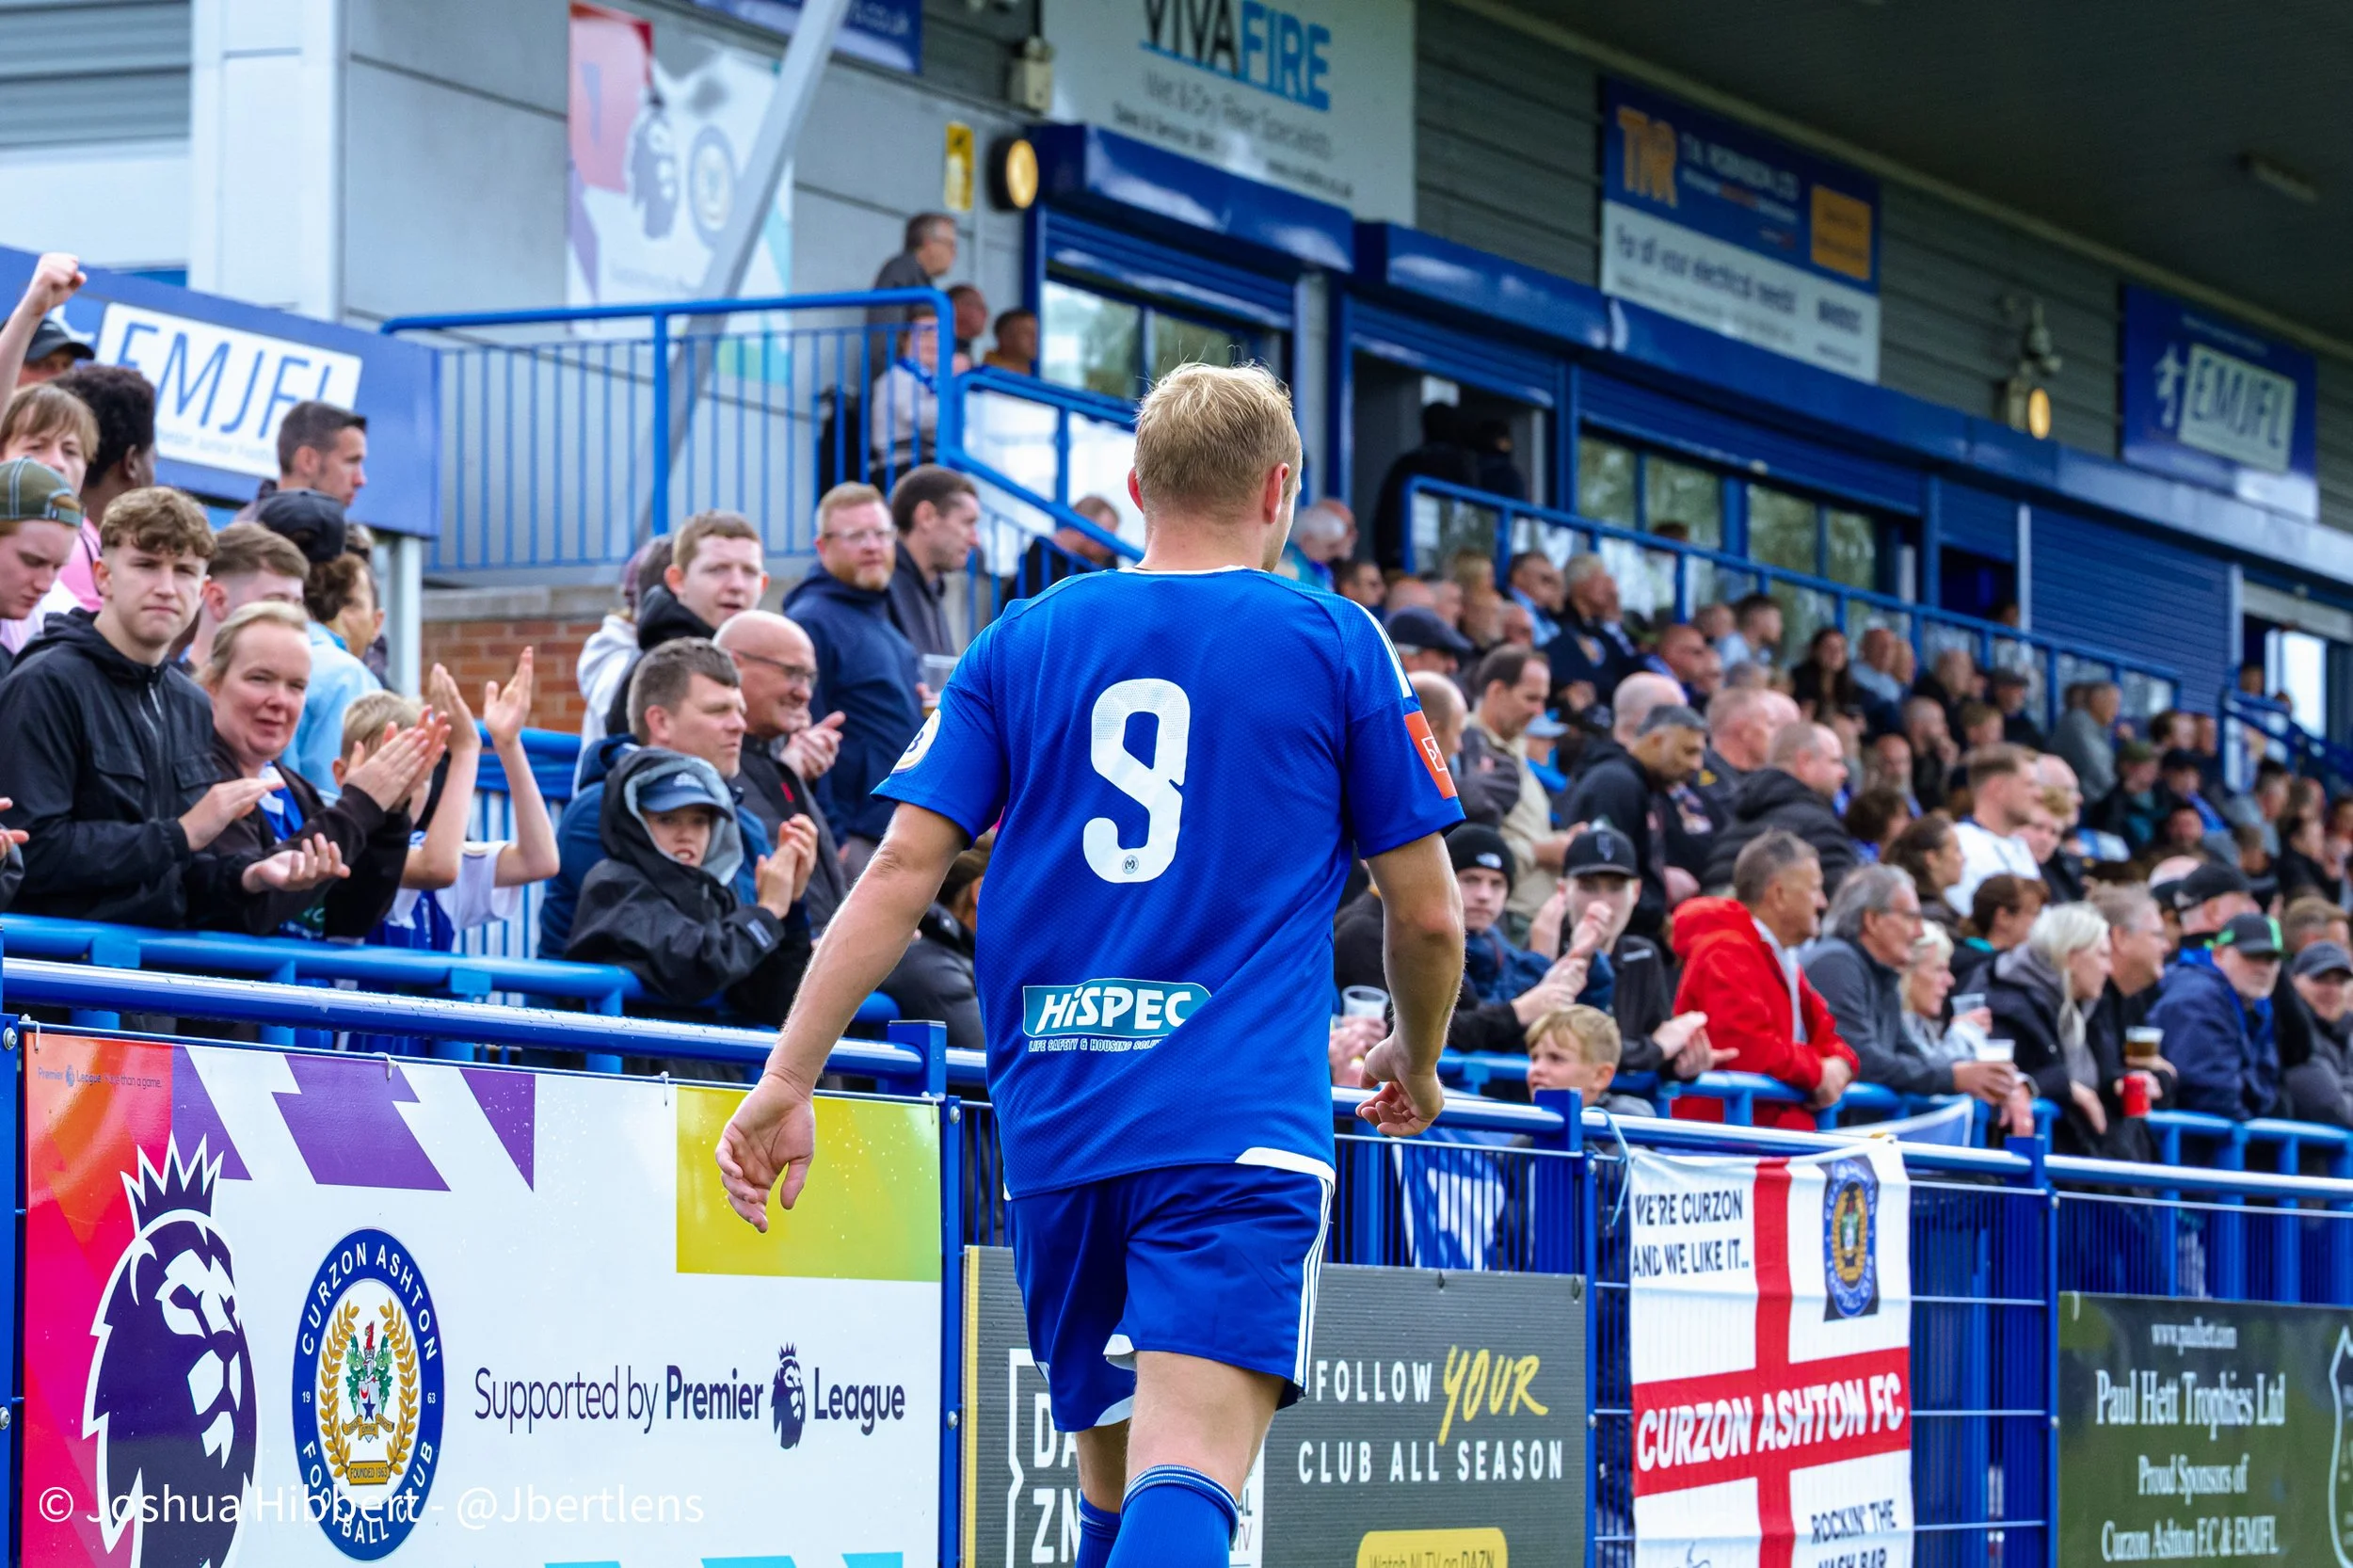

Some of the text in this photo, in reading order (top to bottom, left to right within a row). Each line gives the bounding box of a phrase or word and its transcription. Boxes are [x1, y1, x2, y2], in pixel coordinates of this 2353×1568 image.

[1082, 678, 1191, 884] 9
[1028, 1039, 1047, 1053] LIFE
[1048, 1037, 1079, 1052] SAFETY
[1080, 1037, 1088, 1051] &
[1090, 1038, 1131, 1052] HOUSING
[38, 1066, 64, 1080] Premier
[76, 1069, 102, 1085] League
[1682, 1189, 1743, 1224] CURZON
[1633, 1243, 1662, 1278] AND
[1664, 1242, 1688, 1275] WE
[1691, 1240, 1723, 1273] LIKE
[301, 1241, 439, 1361] CURZON ASHTON
[302, 1391, 312, 1404] 19
[427, 1392, 437, 1405] 63
[474, 1365, 905, 1436] Supported by Premier League
[1316, 1344, 1550, 1447] FOLLOW YOUR
[2095, 1368, 2137, 1426] Paul
[2139, 1369, 2180, 1426] Hett
[2181, 1370, 2255, 1442] Trophies
[2255, 1370, 2286, 1427] Ltd
[1636, 1371, 1905, 1473] CURZON ASHTON FC
[350, 1467, 376, 1479] FOUNDED
[1297, 1439, 1563, 1484] CLUB ALL SEASON
[2137, 1452, 2250, 1506] Proud Sponsors of
[1869, 1498, 1897, 1533] THE
[2101, 1519, 2151, 1563] Curzon
[2151, 1516, 2197, 1560] Ashton
[2218, 1515, 2233, 1558] &
